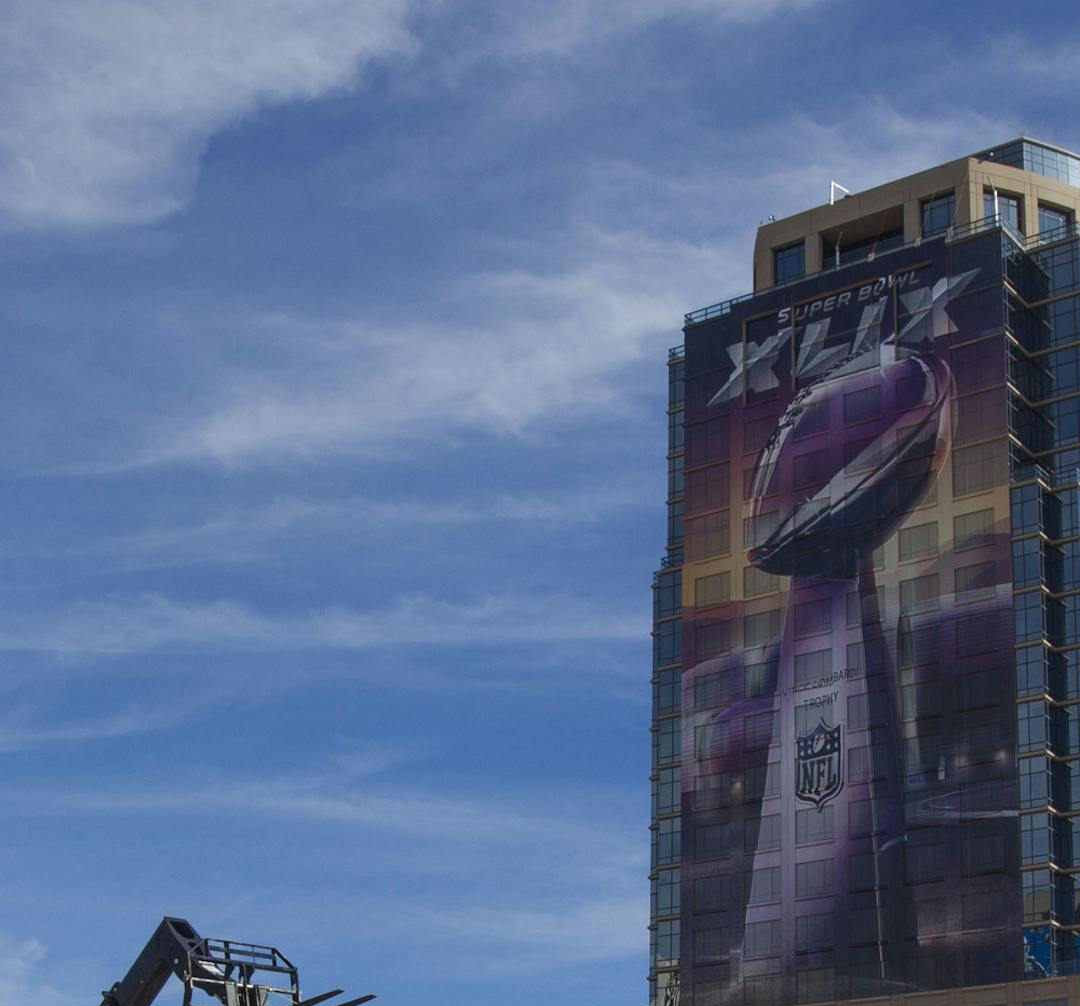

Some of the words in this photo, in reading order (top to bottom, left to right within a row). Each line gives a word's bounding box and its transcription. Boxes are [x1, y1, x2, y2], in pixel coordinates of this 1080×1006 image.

[777, 295, 850, 323] SUPER
[858, 271, 920, 299] BOWL
[706, 267, 983, 408] XLIX
[803, 691, 840, 711] TROPHY
[800, 756, 837, 796] NFL
